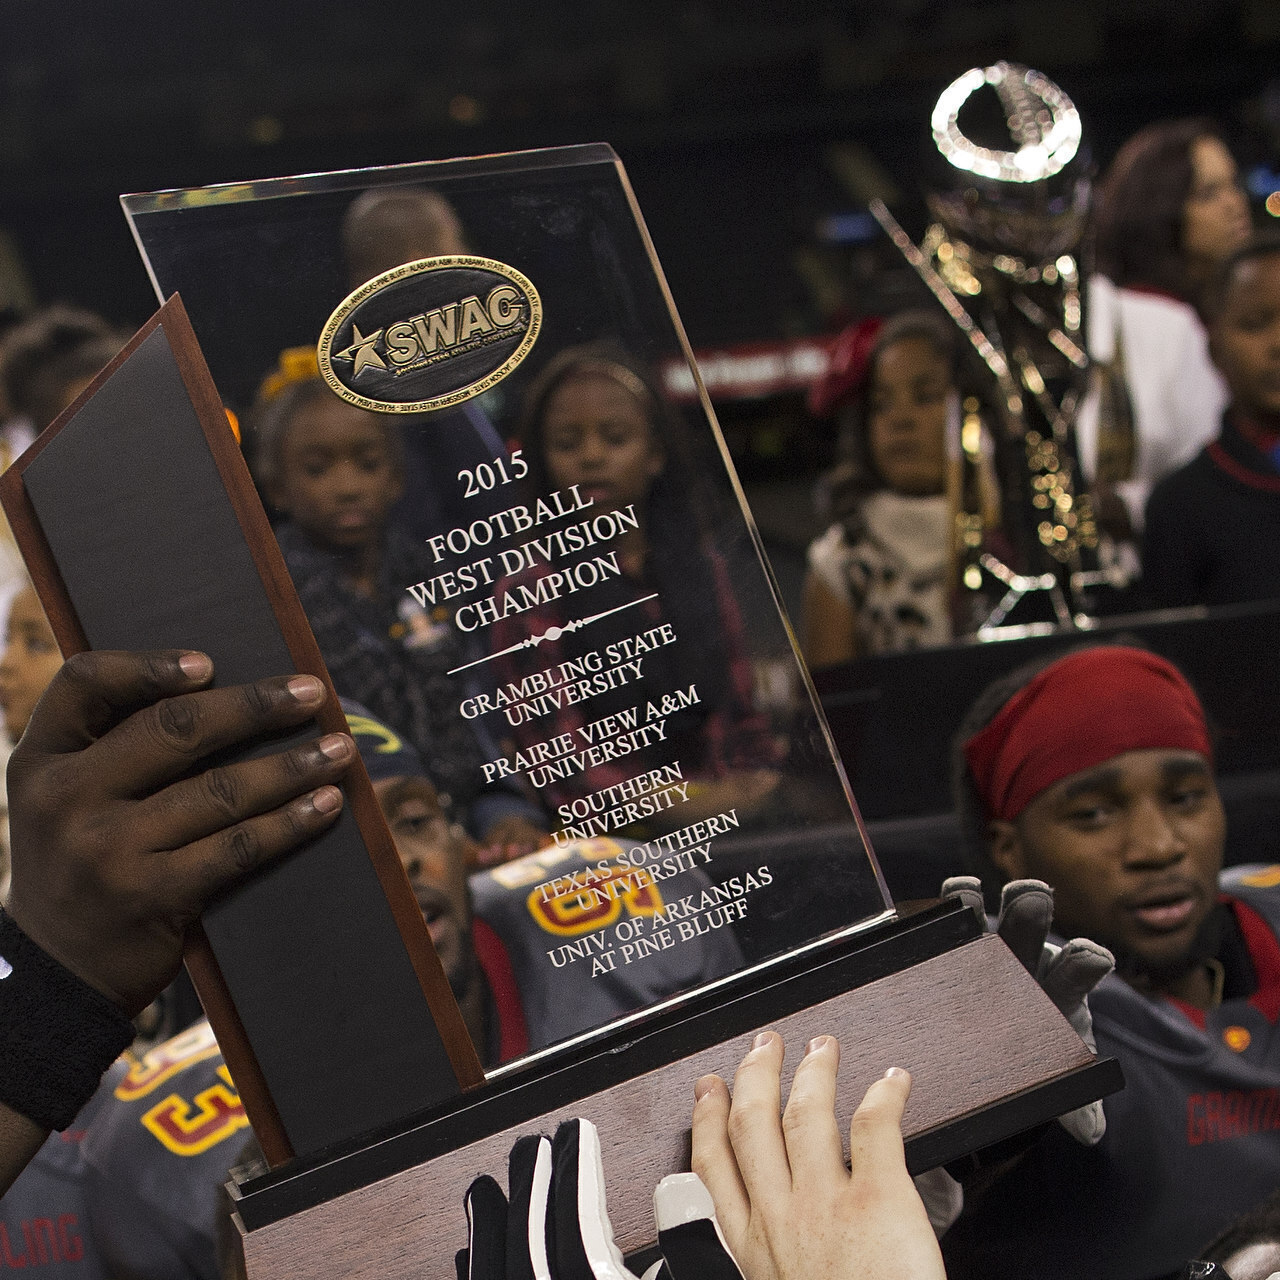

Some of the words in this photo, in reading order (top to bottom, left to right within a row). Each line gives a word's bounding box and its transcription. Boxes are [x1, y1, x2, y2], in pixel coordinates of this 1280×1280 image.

[383, 284, 524, 366] SWAC
[457, 449, 529, 499] 2015
[406, 557, 495, 609] WEST
[497, 504, 640, 577] DIVISION
[426, 483, 594, 563] FOOTBALL
[455, 551, 622, 632] CHAMPION
[459, 651, 603, 720] GRAMBLING
[605, 623, 677, 665] STATE
[502, 658, 645, 727] UNIVERSITY
[480, 732, 577, 785] PRAIRIE
[576, 707, 638, 744] VIEW
[645, 683, 702, 722] A&M
[526, 719, 668, 789] UNIVERSITY
[550, 781, 691, 850] UNIVERSITY
[558, 760, 685, 825] SOUTHERN
[534, 858, 614, 904] TEXAS
[615, 808, 741, 873] SOUTHERN
[573, 841, 714, 912] UNIVERSITY
[547, 929, 613, 969] UNIV.
[614, 916, 646, 942] OF
[651, 865, 774, 931] ARKANSAS
[590, 950, 618, 979] AT
[618, 928, 676, 965] PINE
[676, 897, 748, 943] BLUFF
